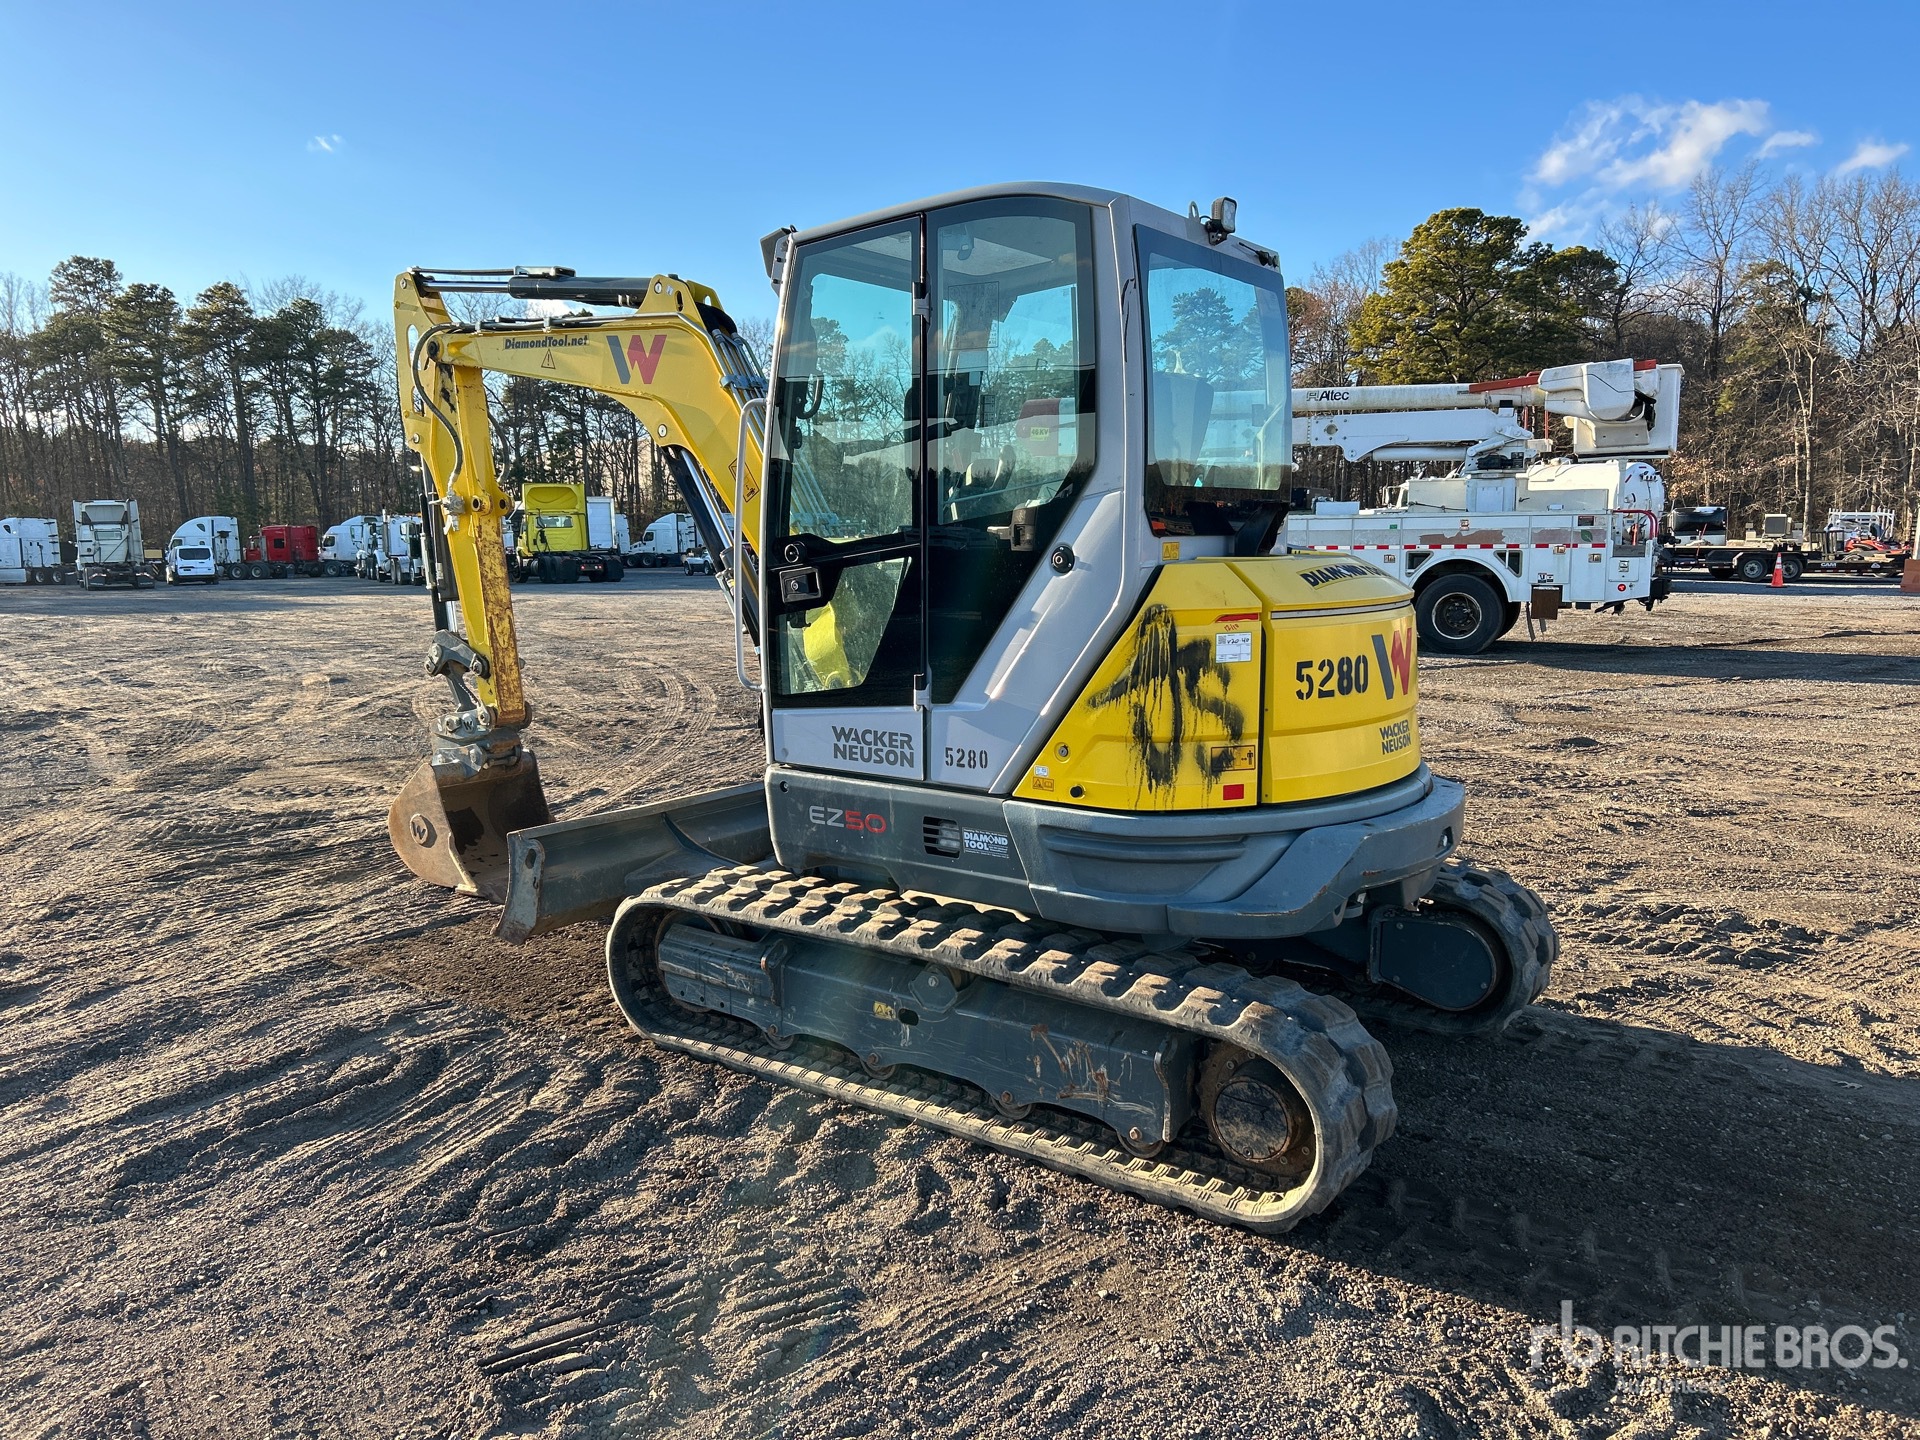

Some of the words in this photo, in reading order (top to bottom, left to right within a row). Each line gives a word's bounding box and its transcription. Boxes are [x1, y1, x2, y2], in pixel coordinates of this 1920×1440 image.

[504, 335, 588, 350] DiamondTool.net
[1319, 390, 1350, 401] Altec
[1300, 564, 1367, 587] DIAMOND
[1295, 654, 1369, 701] 5280
[831, 725, 914, 750] WACKER
[1379, 719, 1409, 740] WACKER
[833, 742, 914, 768] NEUSON
[1381, 733, 1412, 755] NEUSON
[945, 746, 989, 769] 5280
[809, 805, 887, 833] EZ50
[963, 832, 1008, 845] DIAMOND
[965, 840, 989, 850] TOOL
